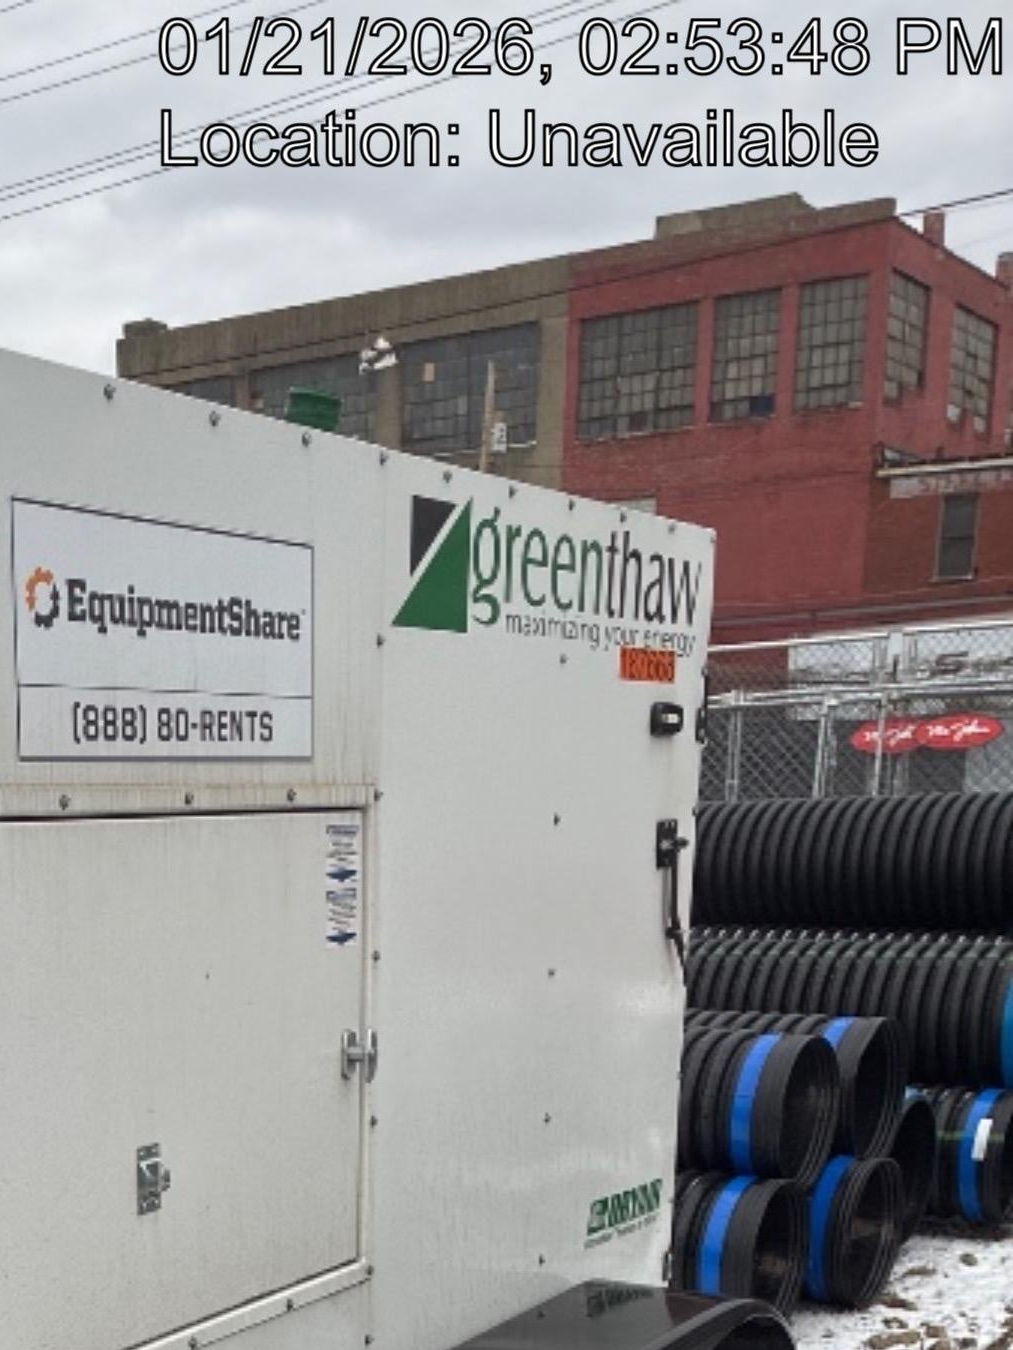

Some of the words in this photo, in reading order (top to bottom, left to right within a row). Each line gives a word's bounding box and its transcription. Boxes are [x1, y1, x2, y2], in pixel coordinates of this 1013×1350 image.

[471, 505, 702, 626] greenthaw
[65, 577, 301, 642] EquipmentShare
[505, 613, 601, 652] maximizing
[72, 701, 147, 744] (888)
[156, 705, 274, 744] 80-RENTS
